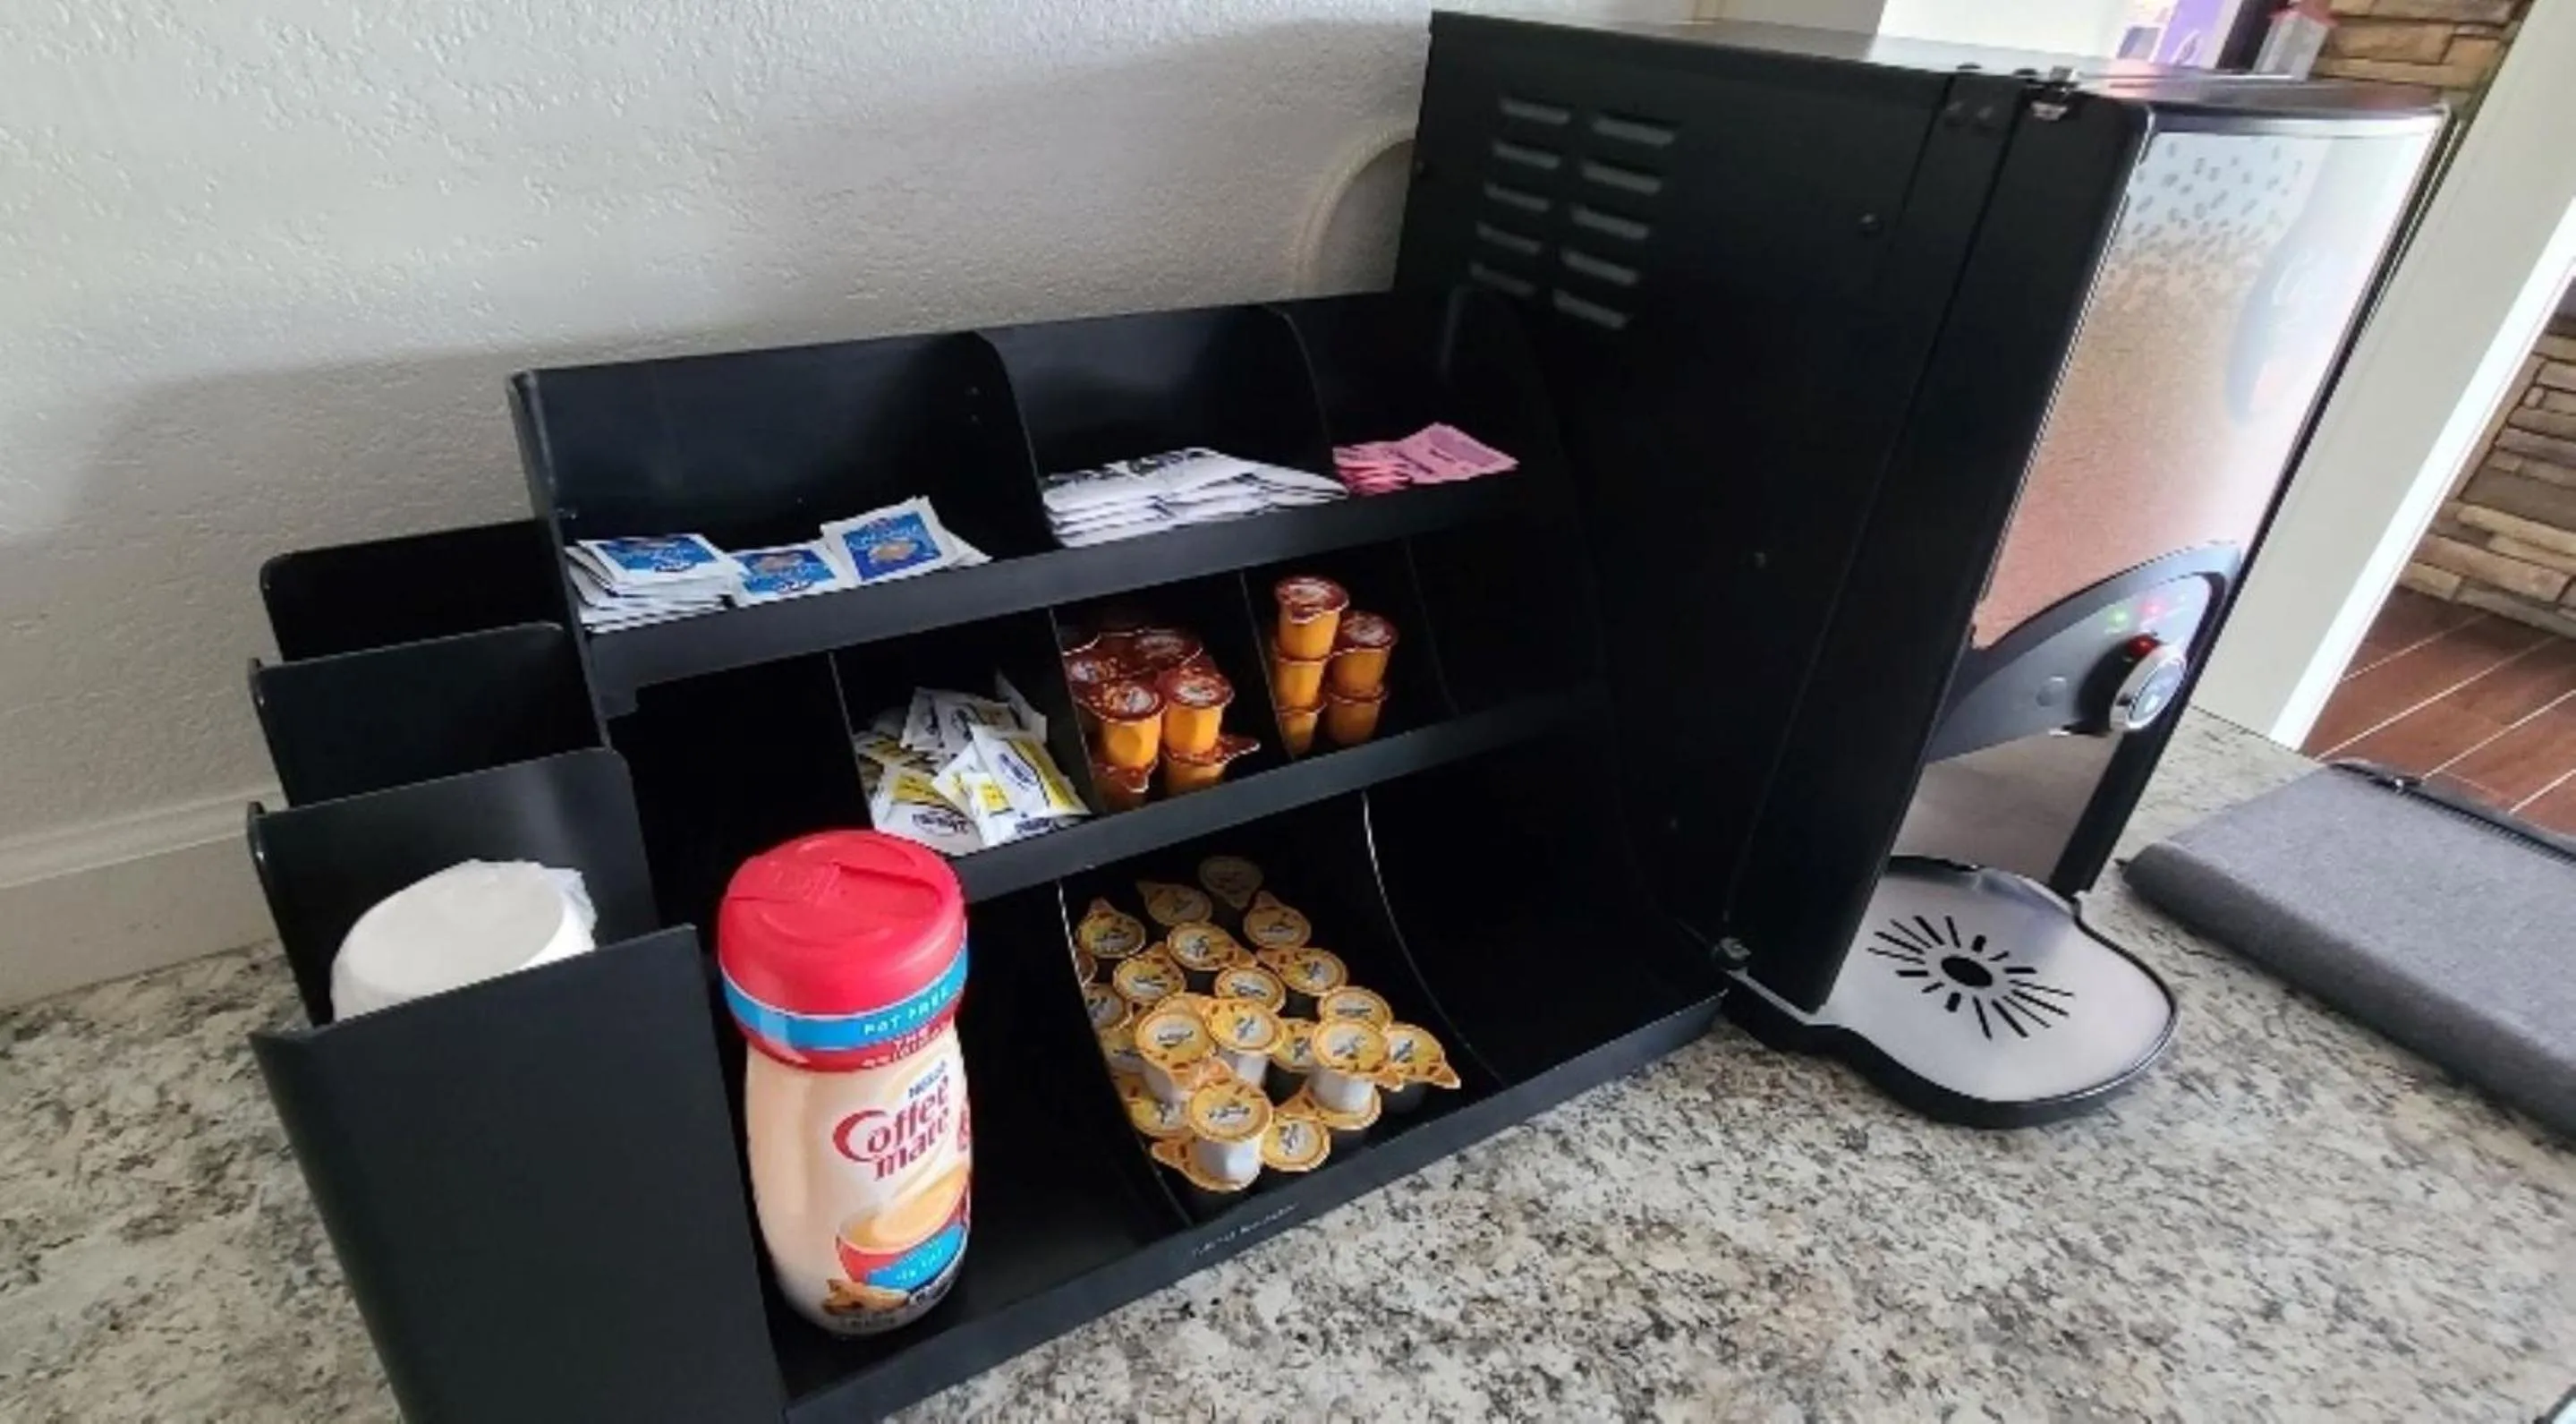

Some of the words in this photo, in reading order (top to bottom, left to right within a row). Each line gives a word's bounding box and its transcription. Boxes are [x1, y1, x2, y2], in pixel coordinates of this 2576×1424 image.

[863, 1014, 900, 1036] FAT
[833, 1075, 949, 1162] Coffee
[875, 1107, 949, 1181] mate
